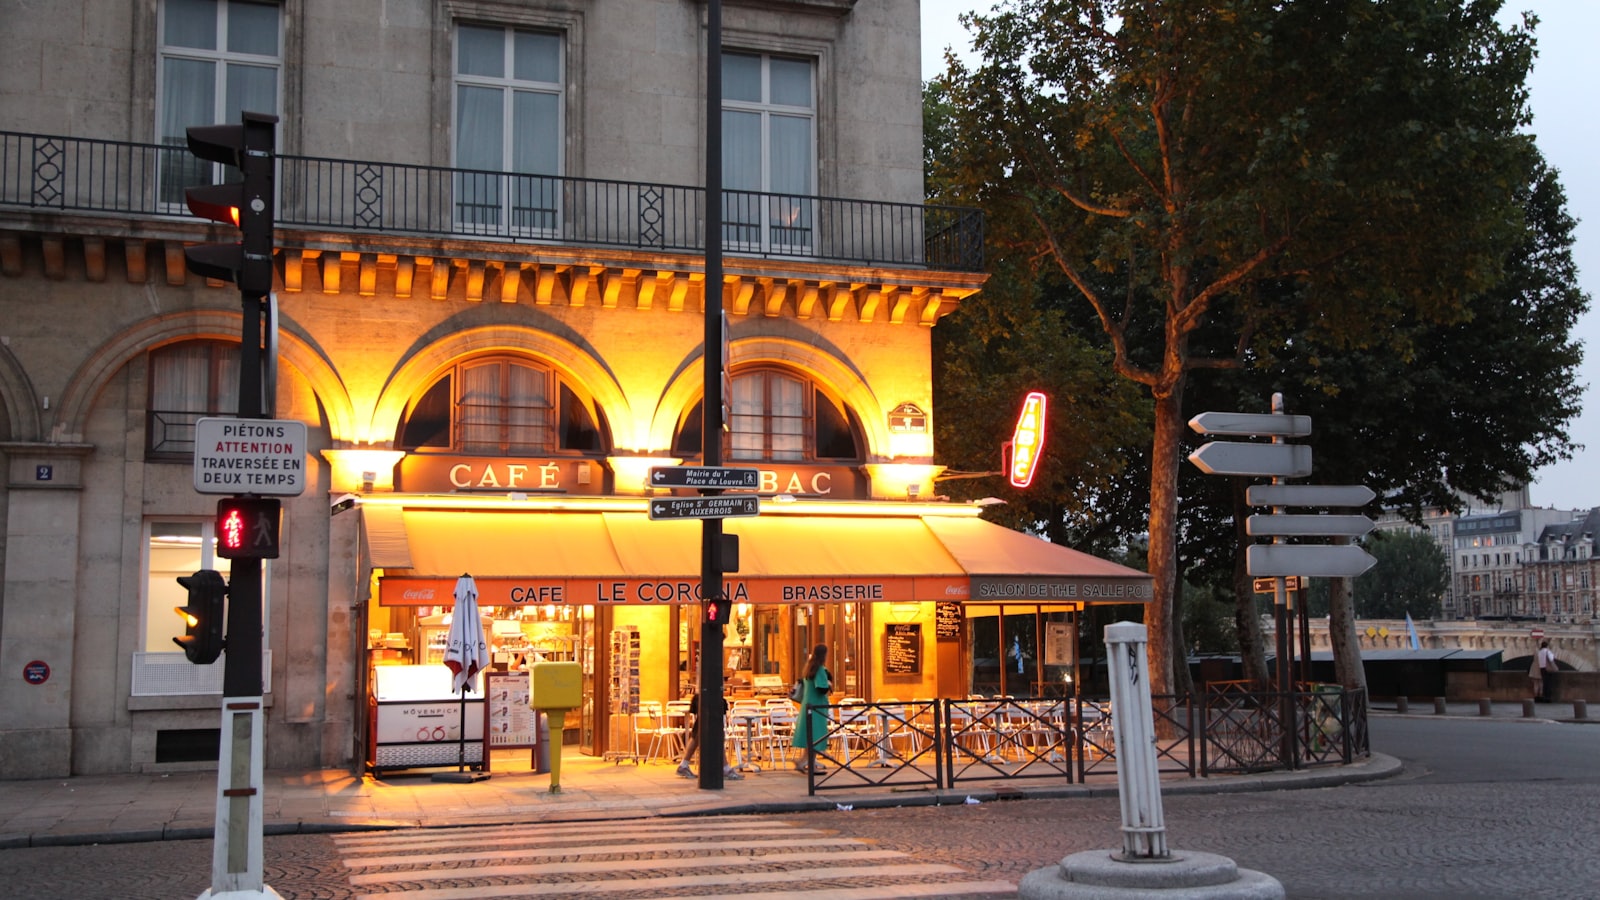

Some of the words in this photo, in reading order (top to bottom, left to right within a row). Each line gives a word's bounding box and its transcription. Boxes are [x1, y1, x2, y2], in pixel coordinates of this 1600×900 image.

[224, 424, 284, 437] PIÉTONS
[1015, 398, 1038, 477] TABAC
[216, 442, 292, 454] ATTENTION
[201, 456, 279, 469] TRAVERSÉE
[283, 459, 300, 470] EN
[40, 467, 49, 479] 2
[204, 472, 242, 484] DEUX
[247, 473, 295, 485] TEMPS
[449, 462, 560, 488] CAFÉ
[730, 470, 831, 494] BAC
[671, 501, 694, 510] Eglise
[708, 499, 743, 507] GERMAIN
[689, 507, 732, 515] AUXERROIS
[510, 587, 563, 603] CAFE
[597, 582, 627, 602] LE
[782, 584, 883, 600] BRASSERIE
[980, 584, 1025, 597] SALON
[1029, 583, 1048, 597] DE
[1050, 584, 1077, 597] THE
[1082, 585, 1123, 597] SALLE
